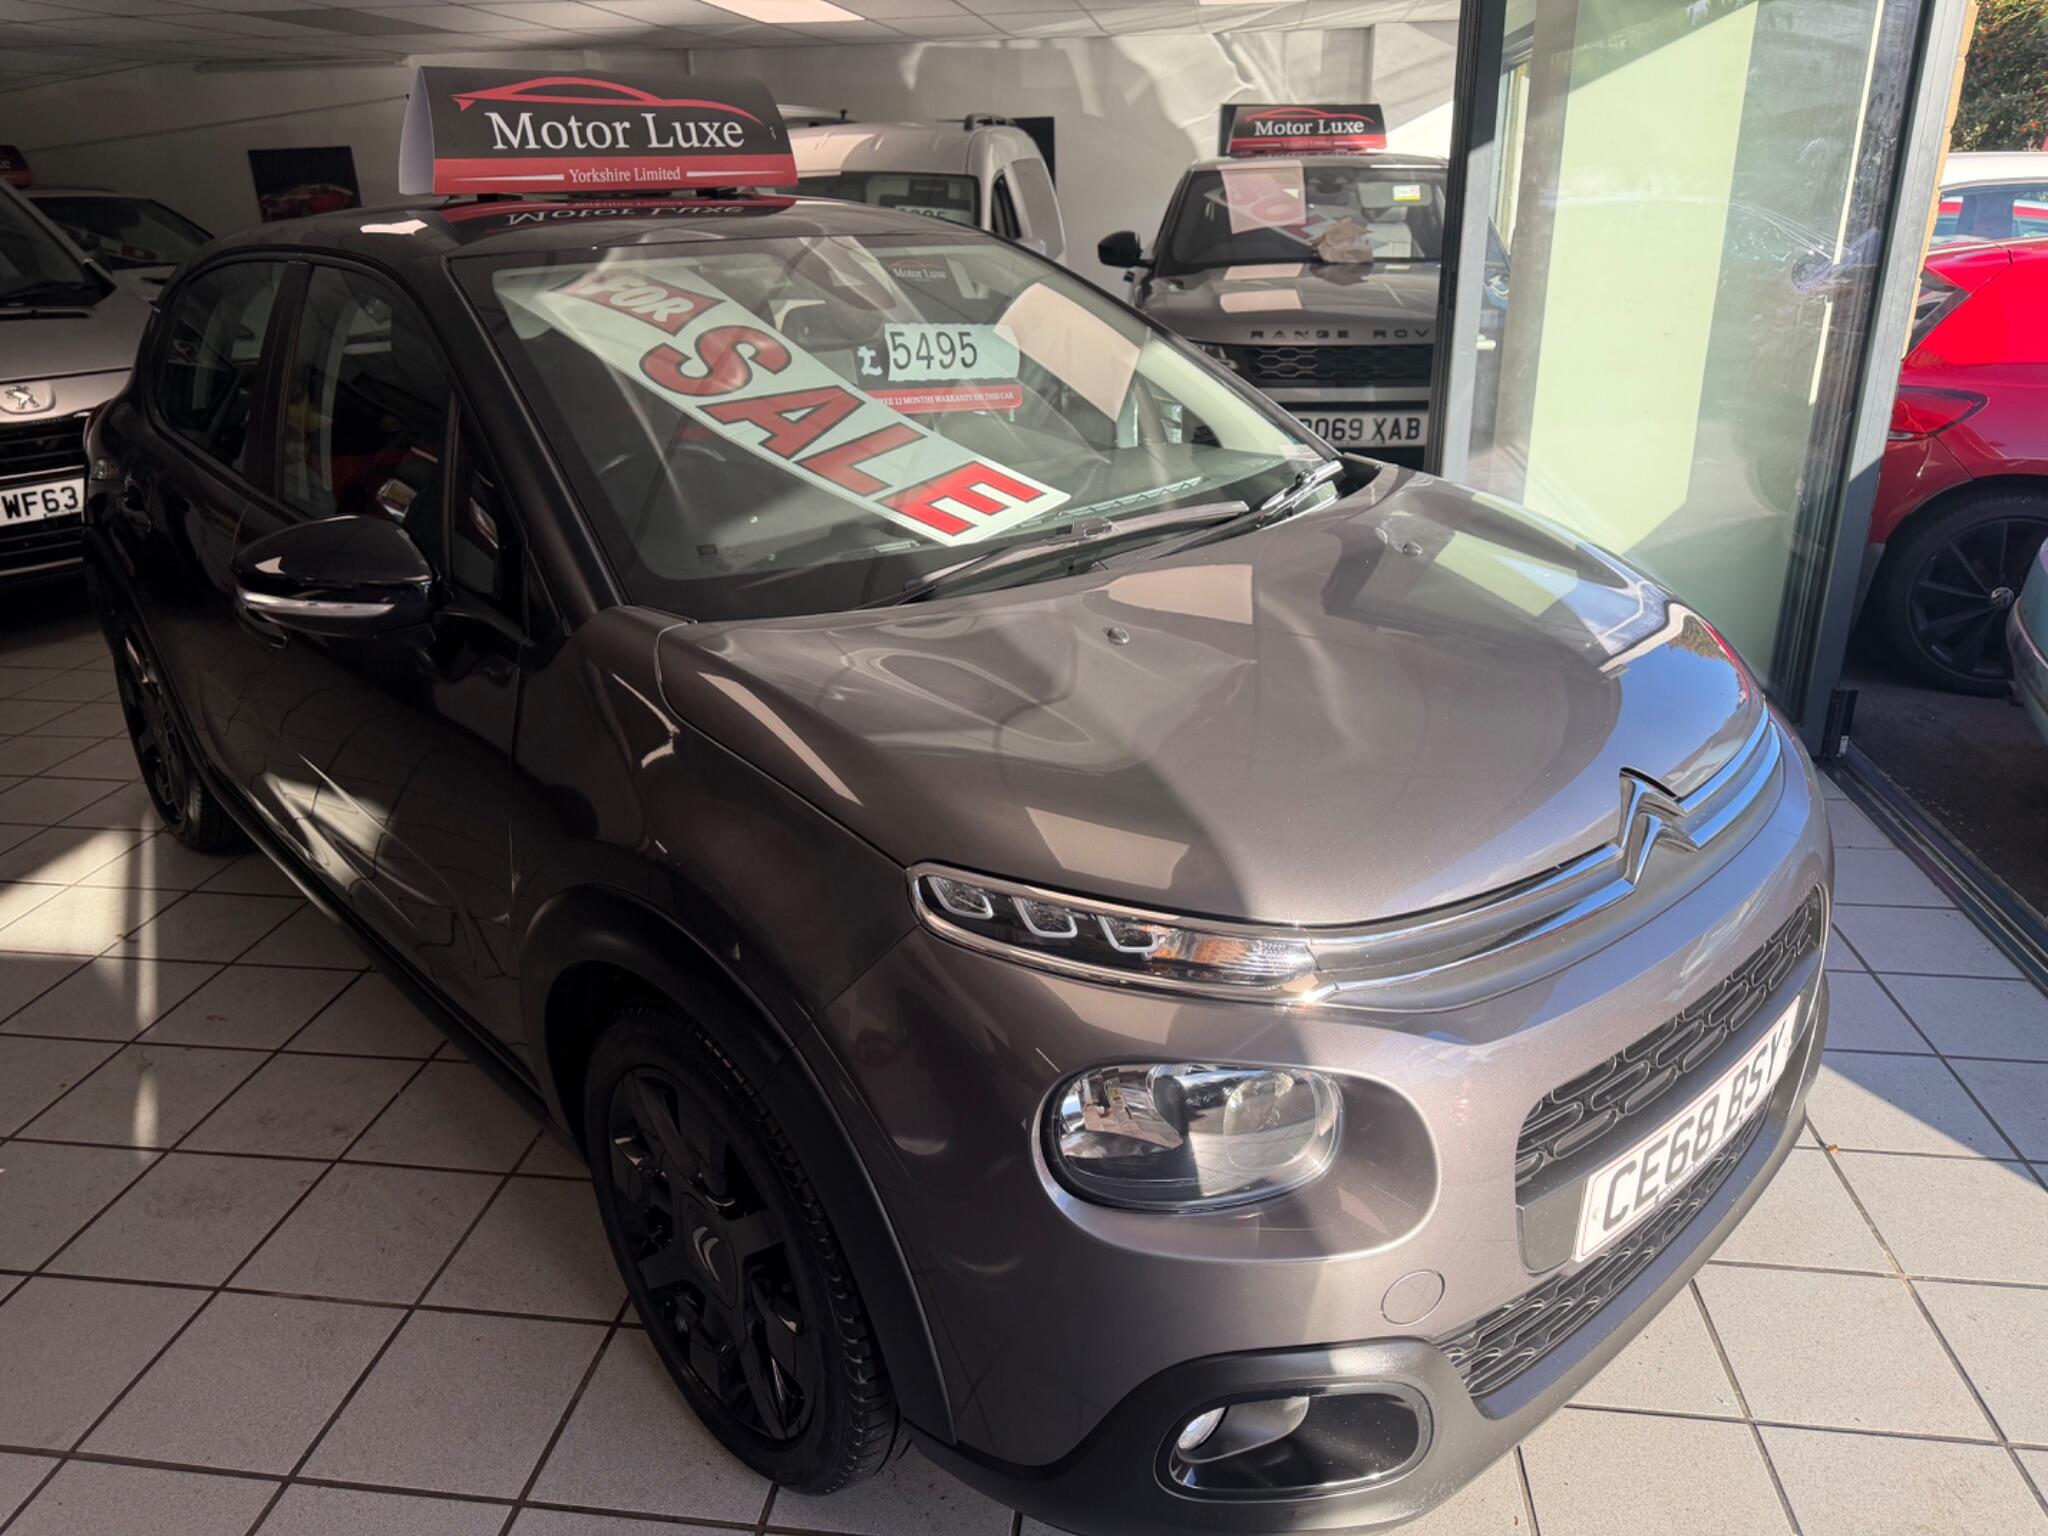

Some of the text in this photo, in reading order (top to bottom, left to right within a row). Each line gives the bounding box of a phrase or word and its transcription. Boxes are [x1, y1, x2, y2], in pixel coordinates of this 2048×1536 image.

[485, 111, 745, 150] Motor Luxe
[1254, 118, 1365, 137] Motor Luxe
[568, 166, 681, 183] Yorkshire Limited
[1250, 330, 1350, 340] RANGE
[575, 275, 1047, 537] FOR SALE
[903, 395, 935, 405] MONTHS
[935, 393, 973, 404] WARRANTY
[1371, 417, 1422, 444] XAB
[1, 485, 79, 520] WF63
[1602, 1093, 1721, 1232] CE68
[1722, 1019, 1788, 1138] BSY
